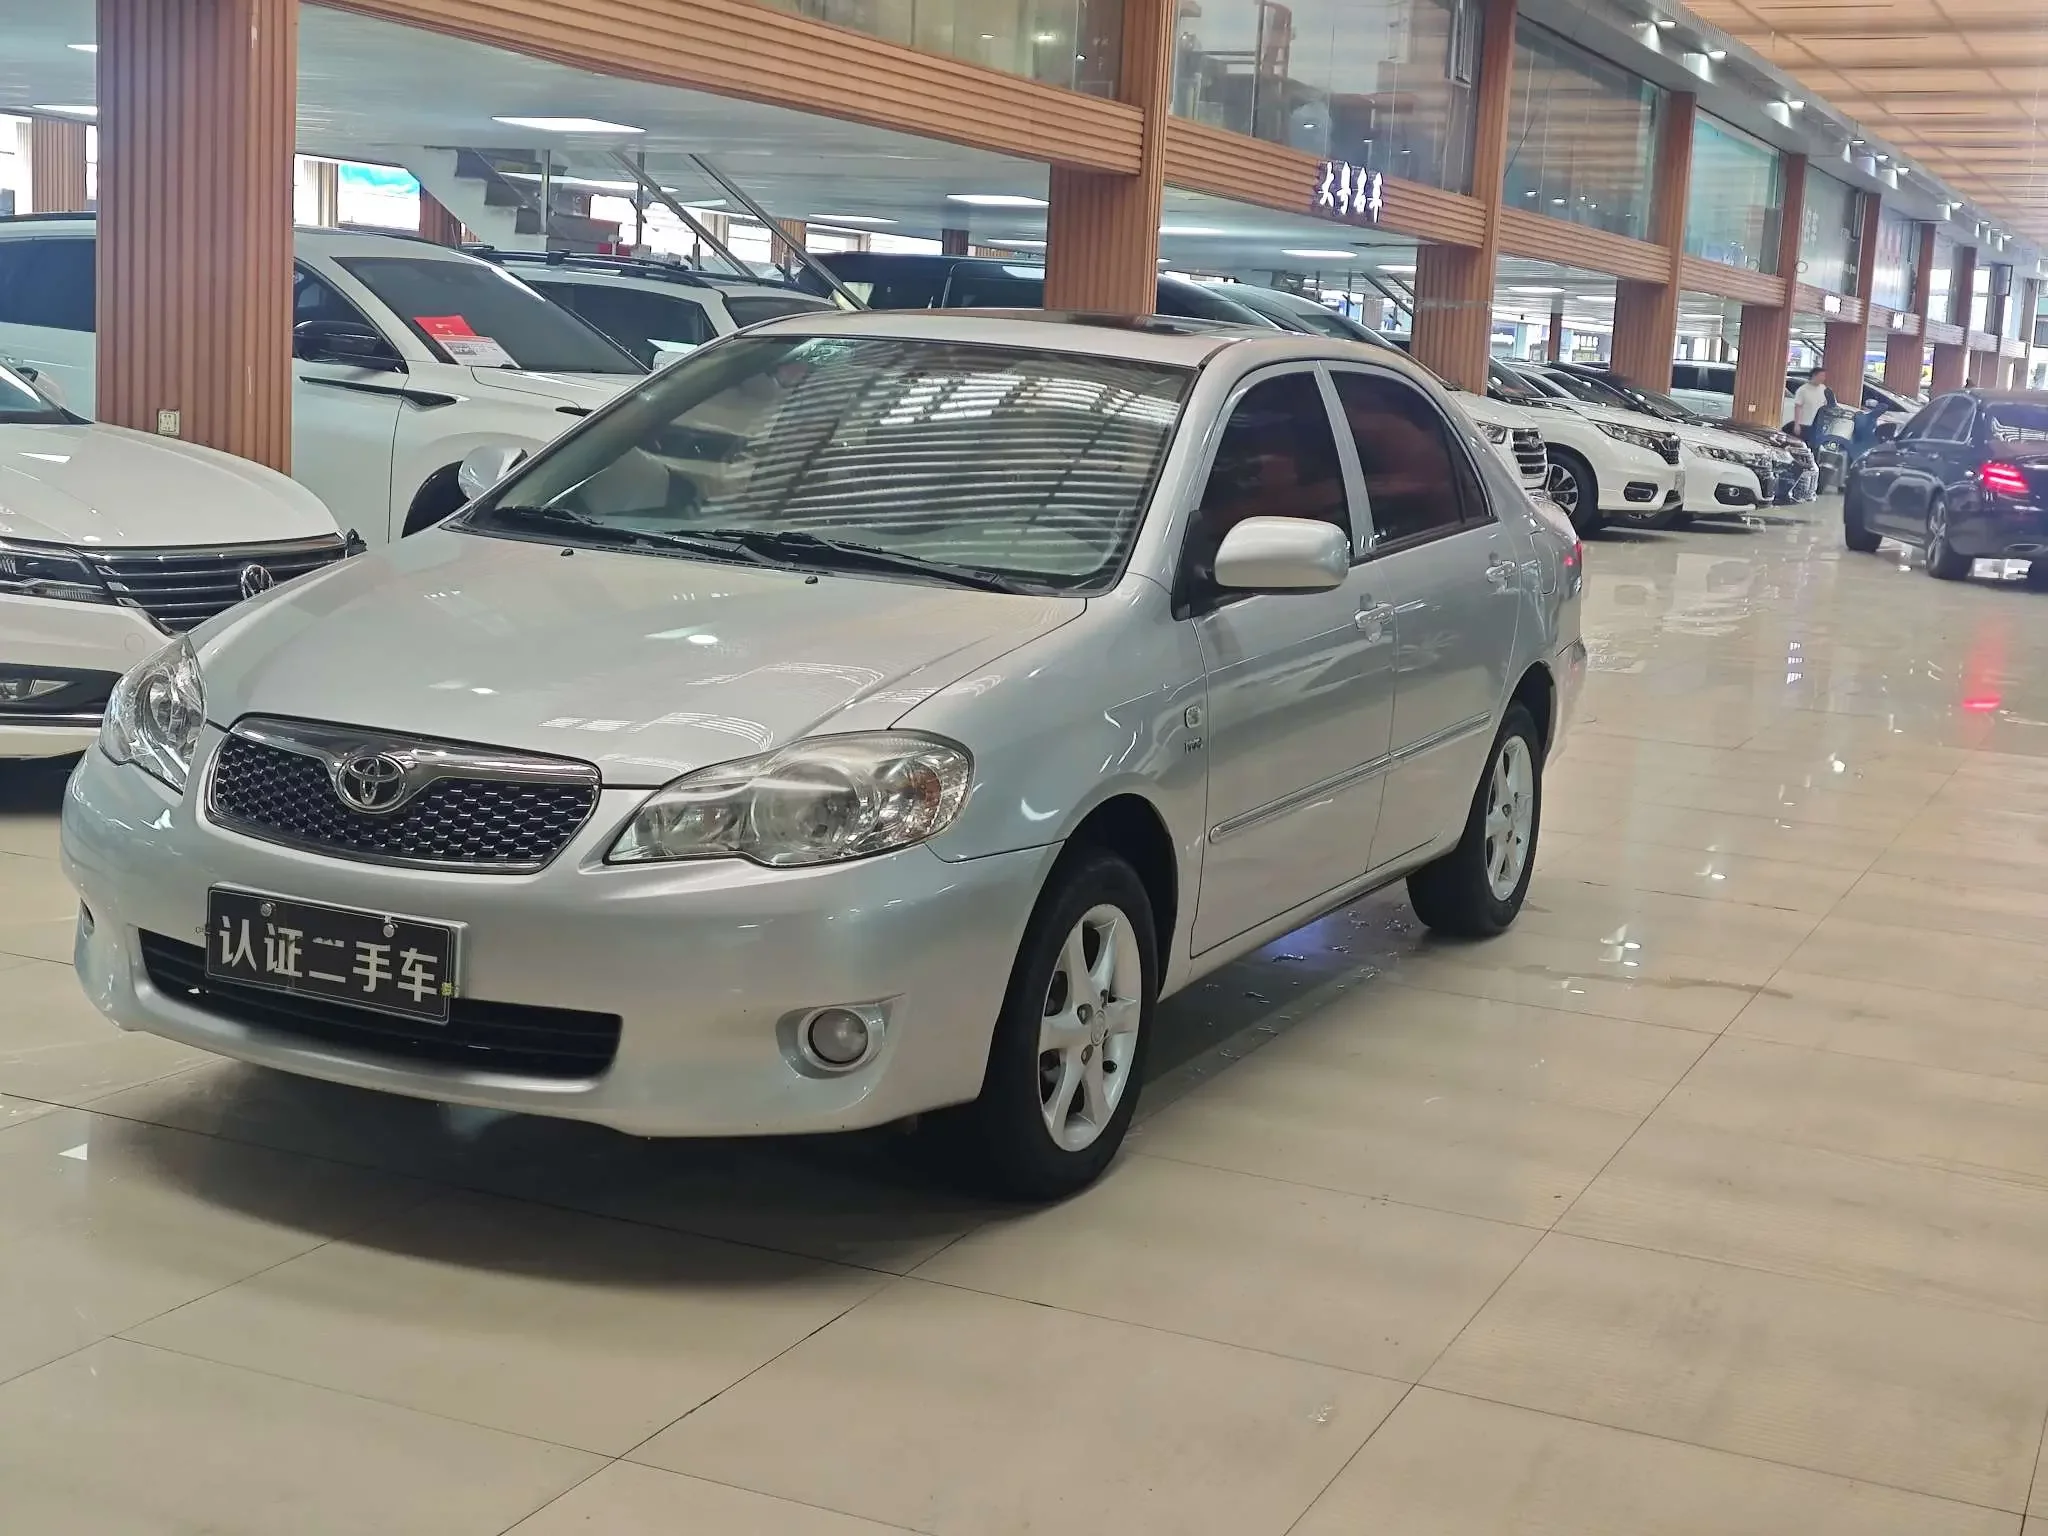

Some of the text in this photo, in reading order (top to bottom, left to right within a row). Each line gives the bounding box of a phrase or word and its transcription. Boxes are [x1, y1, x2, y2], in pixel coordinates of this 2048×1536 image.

[218, 915, 438, 1002] 认证二手车
